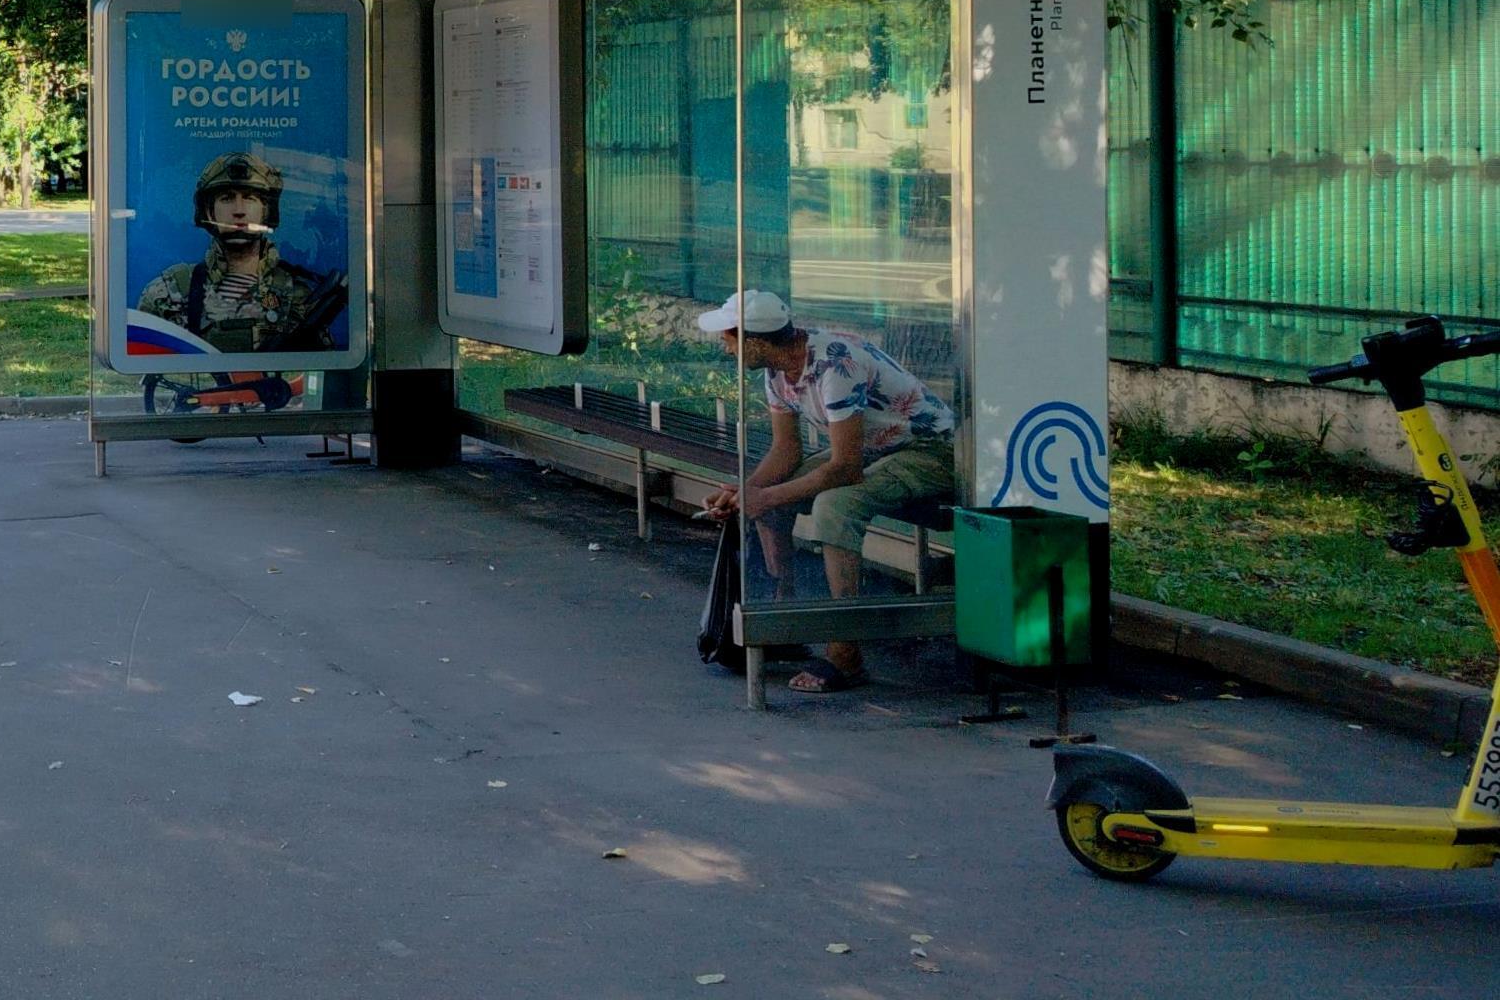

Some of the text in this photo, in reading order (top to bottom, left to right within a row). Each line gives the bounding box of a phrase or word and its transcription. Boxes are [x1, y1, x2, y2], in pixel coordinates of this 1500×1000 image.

[161, 58, 311, 82] ГОРДОСТЬ
[171, 86, 301, 108] РОССИИ!
[174, 117, 298, 129] АРТЕМ РОМАНЦОВ
[1474, 720, 1500, 809] 5539
